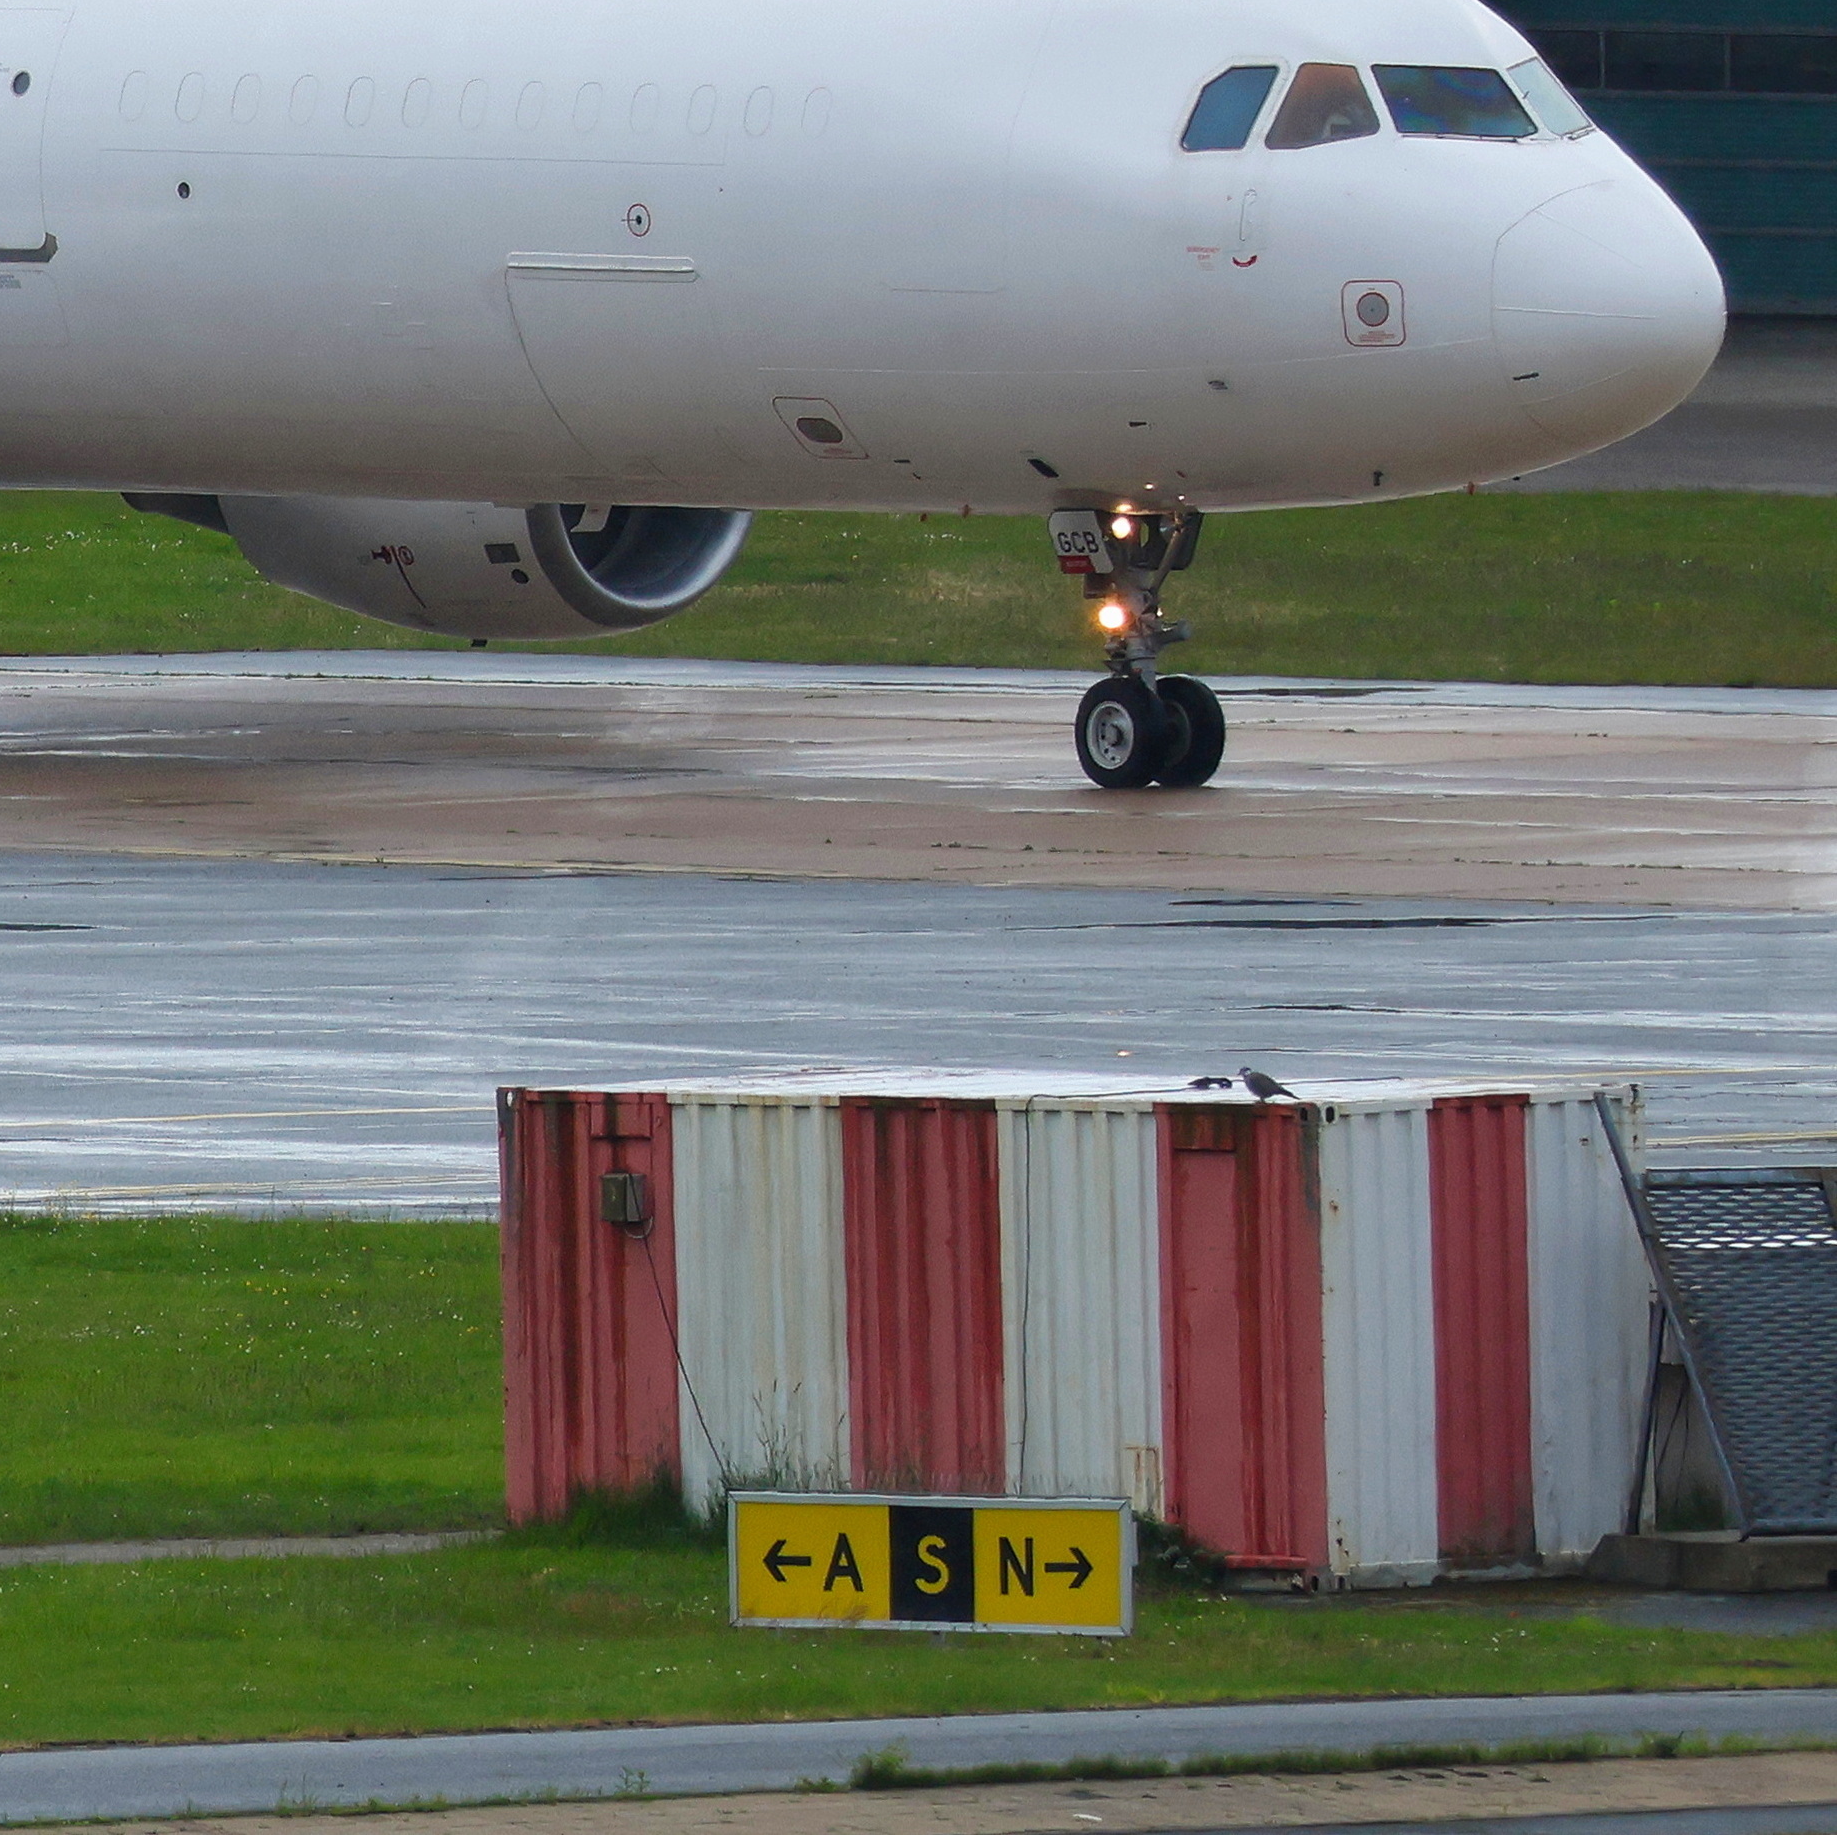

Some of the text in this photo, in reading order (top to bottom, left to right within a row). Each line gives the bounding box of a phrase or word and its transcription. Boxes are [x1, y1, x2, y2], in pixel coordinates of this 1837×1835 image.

[1057, 531, 1099, 553] GCB
[823, 1532, 1035, 1597] A S N
